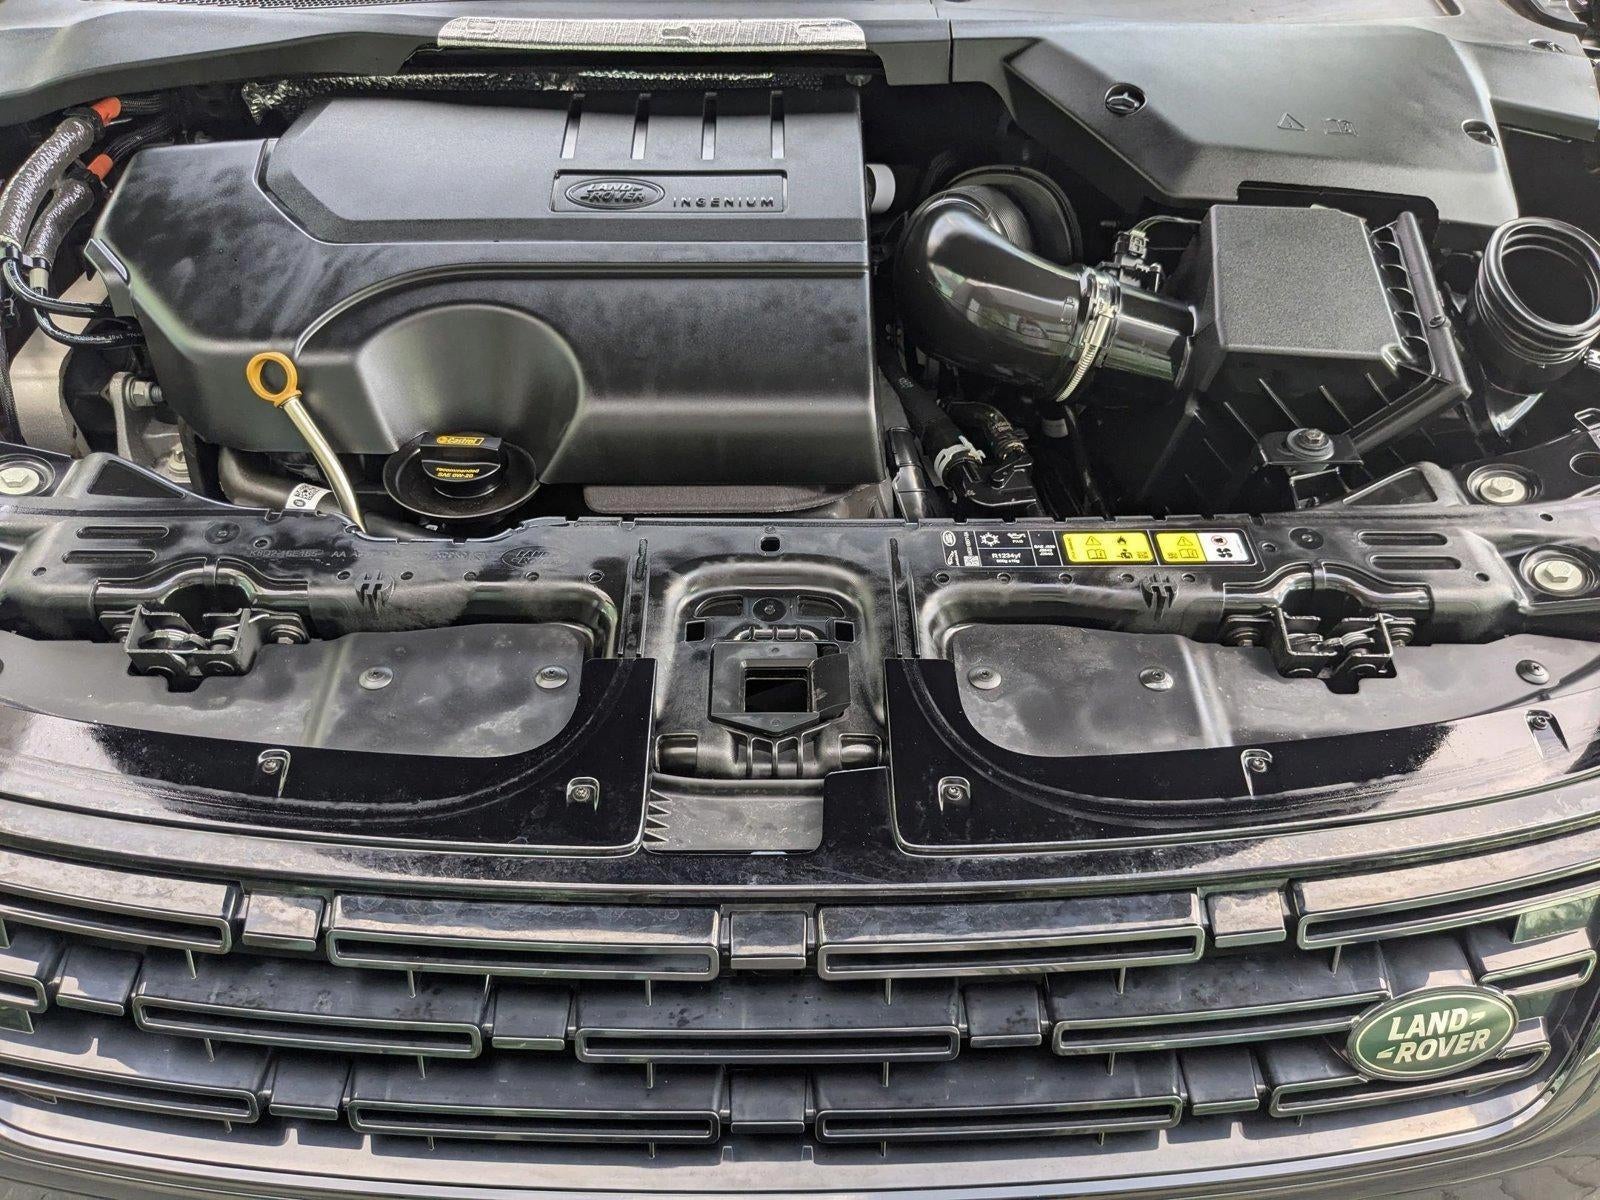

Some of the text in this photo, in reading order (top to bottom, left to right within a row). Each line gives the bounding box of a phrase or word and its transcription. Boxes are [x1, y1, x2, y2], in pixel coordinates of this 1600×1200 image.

[588, 183, 633, 193] LAND
[591, 191, 647, 203] ROVER
[672, 196, 775, 208] INGENIUM
[447, 437, 477, 445] Castrol
[991, 552, 1022, 560] R1234yf
[1387, 1007, 1470, 1041] LAND
[1392, 1028, 1492, 1065] ROVER
